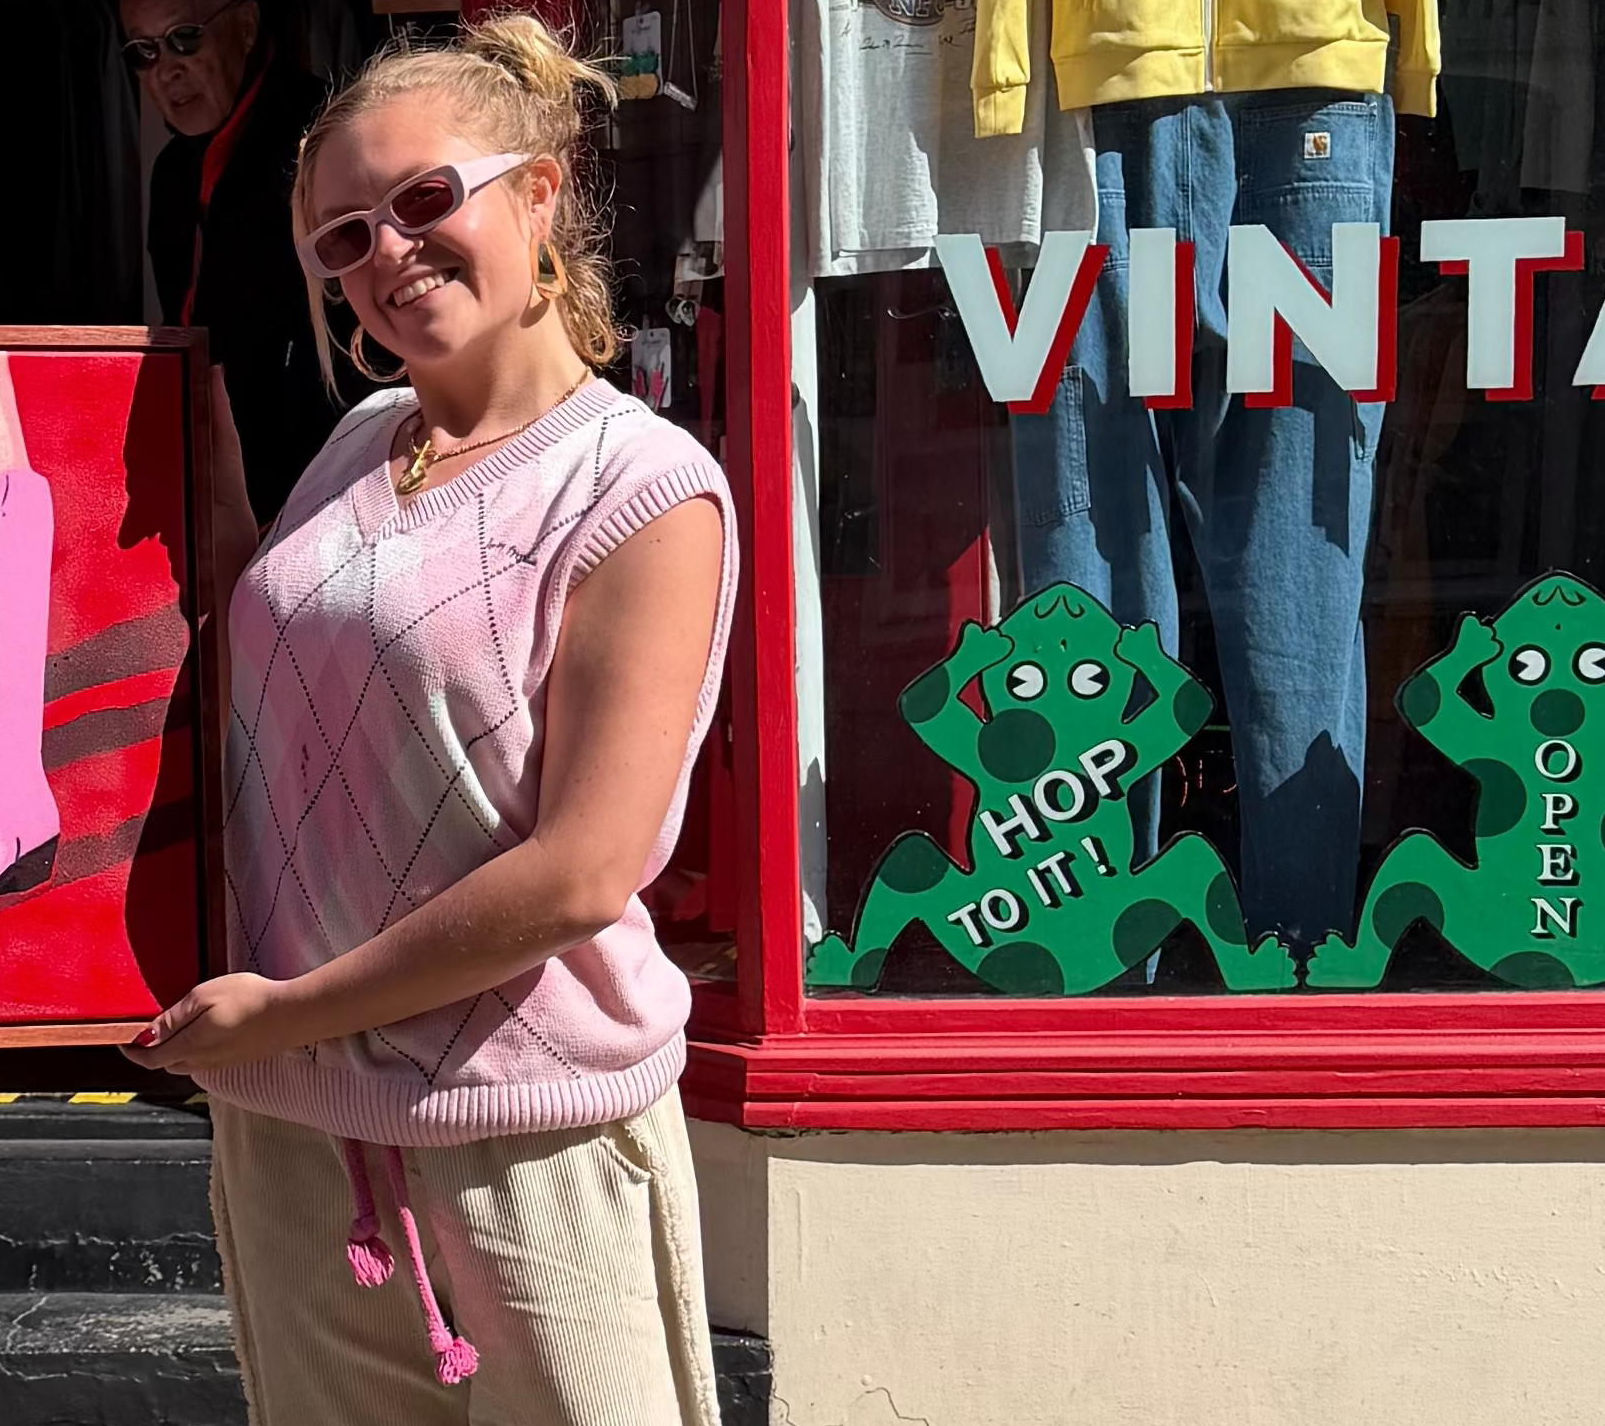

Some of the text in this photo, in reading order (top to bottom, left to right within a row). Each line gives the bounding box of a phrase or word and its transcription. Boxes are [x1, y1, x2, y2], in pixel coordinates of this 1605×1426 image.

[935, 216, 1605, 414] VINT
[979, 739, 1138, 860] HOP
[1530, 739, 1584, 939] OPEN
[947, 888, 1029, 947] TO
